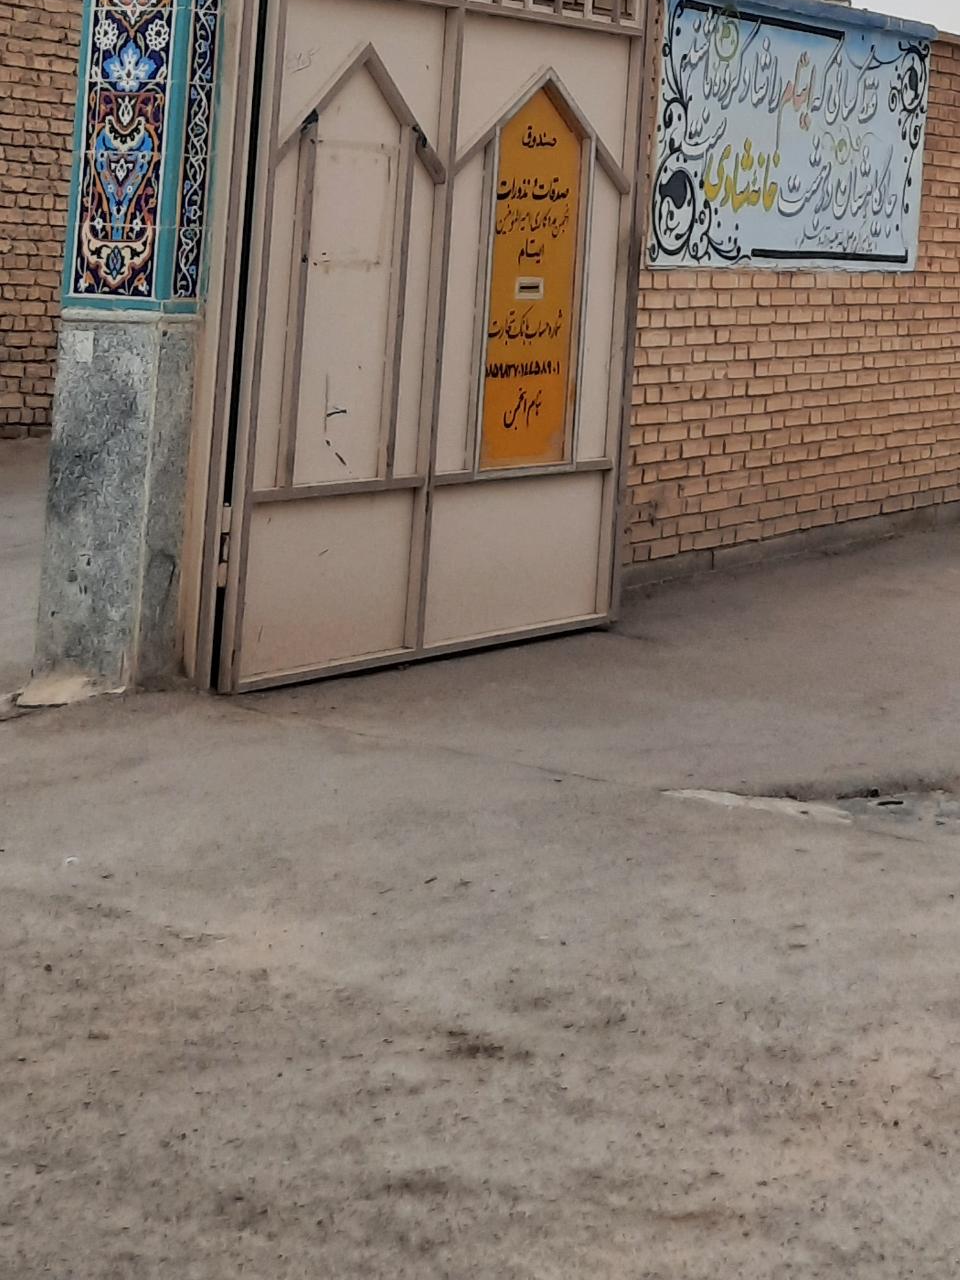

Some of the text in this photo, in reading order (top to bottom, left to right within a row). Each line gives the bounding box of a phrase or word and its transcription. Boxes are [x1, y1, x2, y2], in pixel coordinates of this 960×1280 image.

[521, 125, 558, 148] صندوق
[531, 176, 570, 202] صدقات
[517, 238, 545, 264] ایتام
